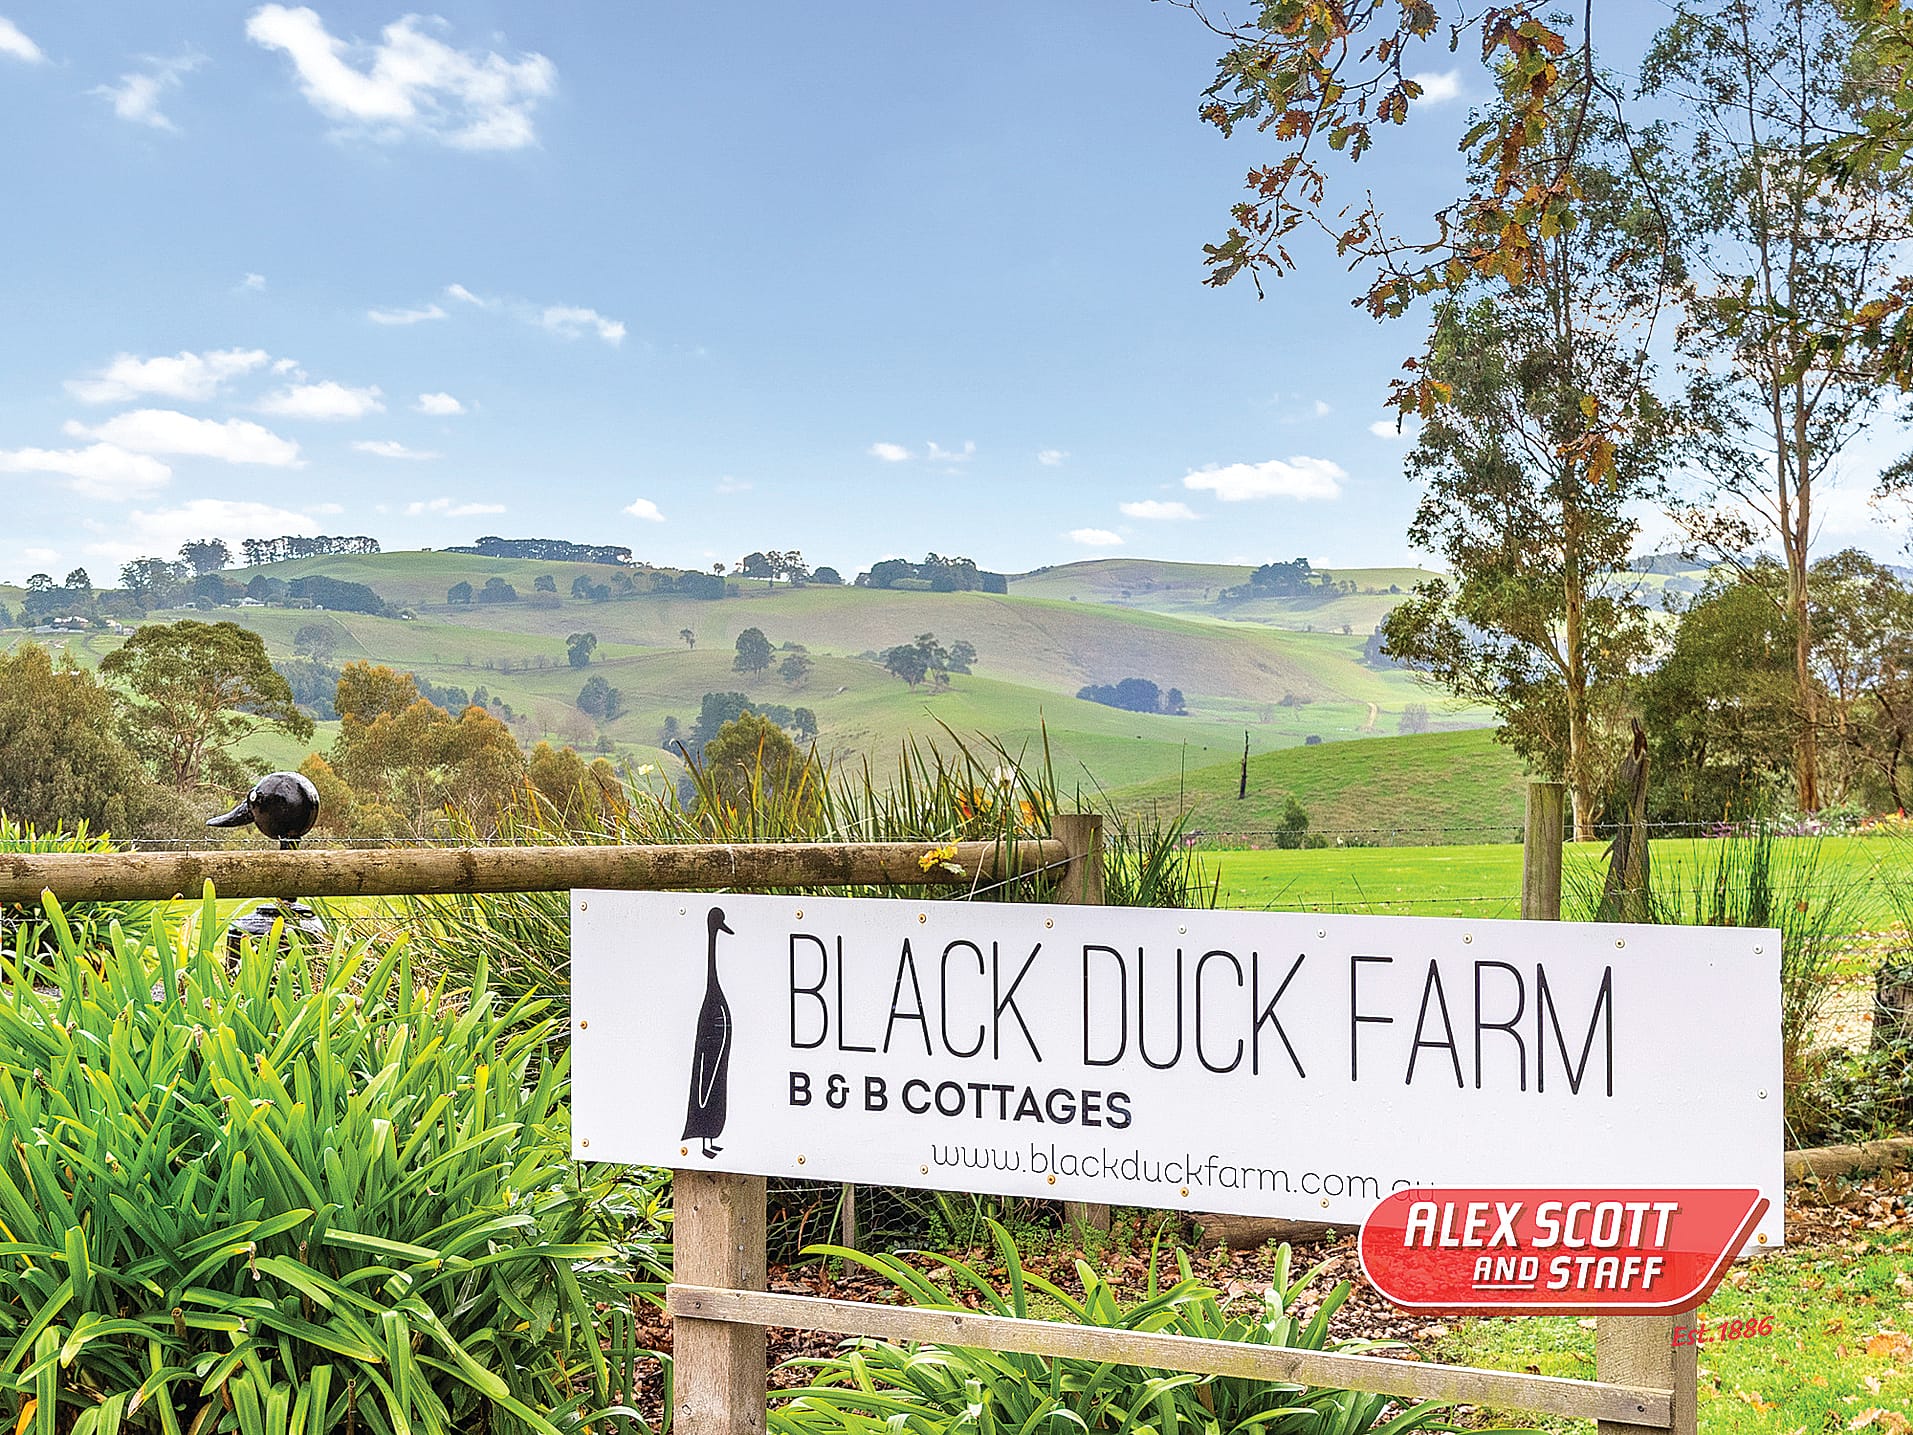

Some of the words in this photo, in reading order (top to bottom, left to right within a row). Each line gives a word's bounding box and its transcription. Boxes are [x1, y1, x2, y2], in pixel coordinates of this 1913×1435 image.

[790, 933, 1042, 1062] BLACK
[1083, 944, 1305, 1078] DUCK
[1350, 955, 1613, 1097] FARM
[789, 1072, 811, 1106] B
[826, 1073, 850, 1109] &
[865, 1076, 888, 1111] B
[902, 1078, 1132, 1129] COTTAGES
[931, 1142, 1434, 1202] www.blackduckfarm.comau
